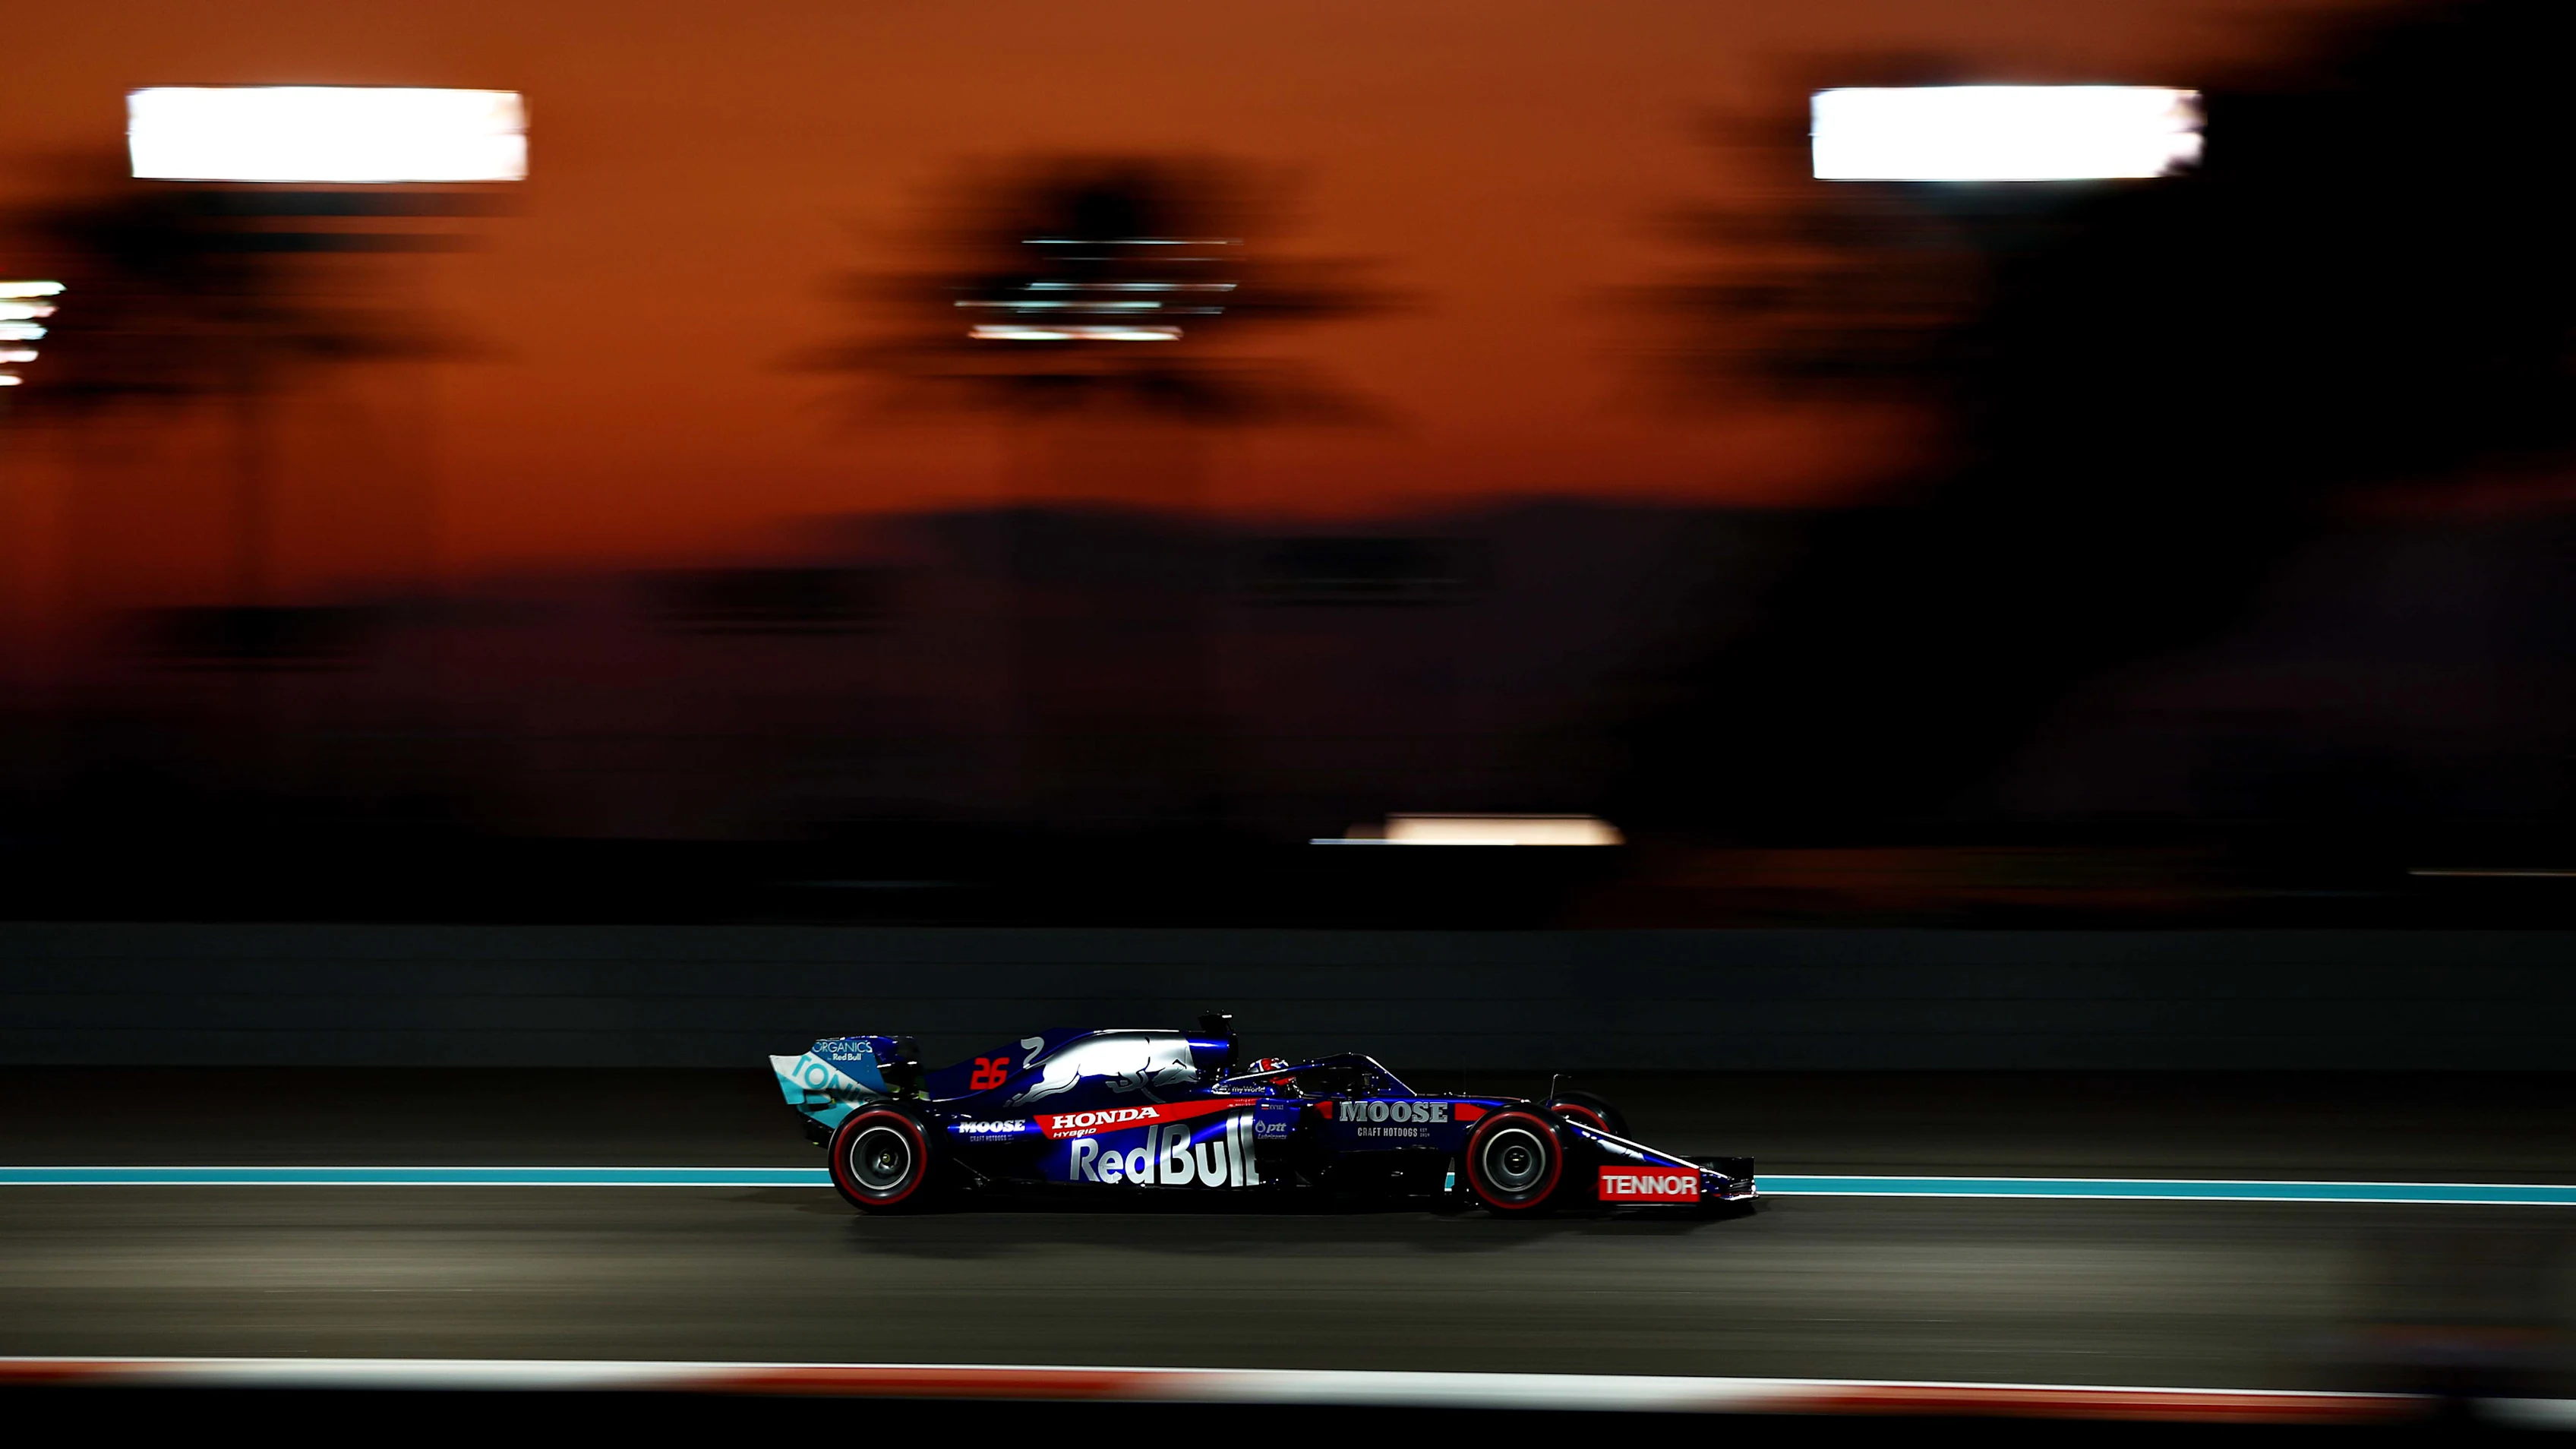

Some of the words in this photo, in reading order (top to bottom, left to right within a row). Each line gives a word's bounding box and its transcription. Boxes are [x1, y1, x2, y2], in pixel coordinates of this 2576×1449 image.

[812, 1041, 873, 1053] ORGANICS
[970, 1057, 1010, 1091] 26
[1232, 1086, 1266, 1094] myWorld
[1052, 1106, 1160, 1129] HONDA
[1340, 1100, 1448, 1122] MOOSE
[958, 1119, 1025, 1133] MOOSE
[1266, 1122, 1287, 1134] ptt
[1357, 1127, 1381, 1137] CRAFT
[1383, 1127, 1418, 1137] HOTDOGS
[1053, 1128, 1097, 1138] HYBRID
[1602, 1176, 1698, 1195] TENNOR
